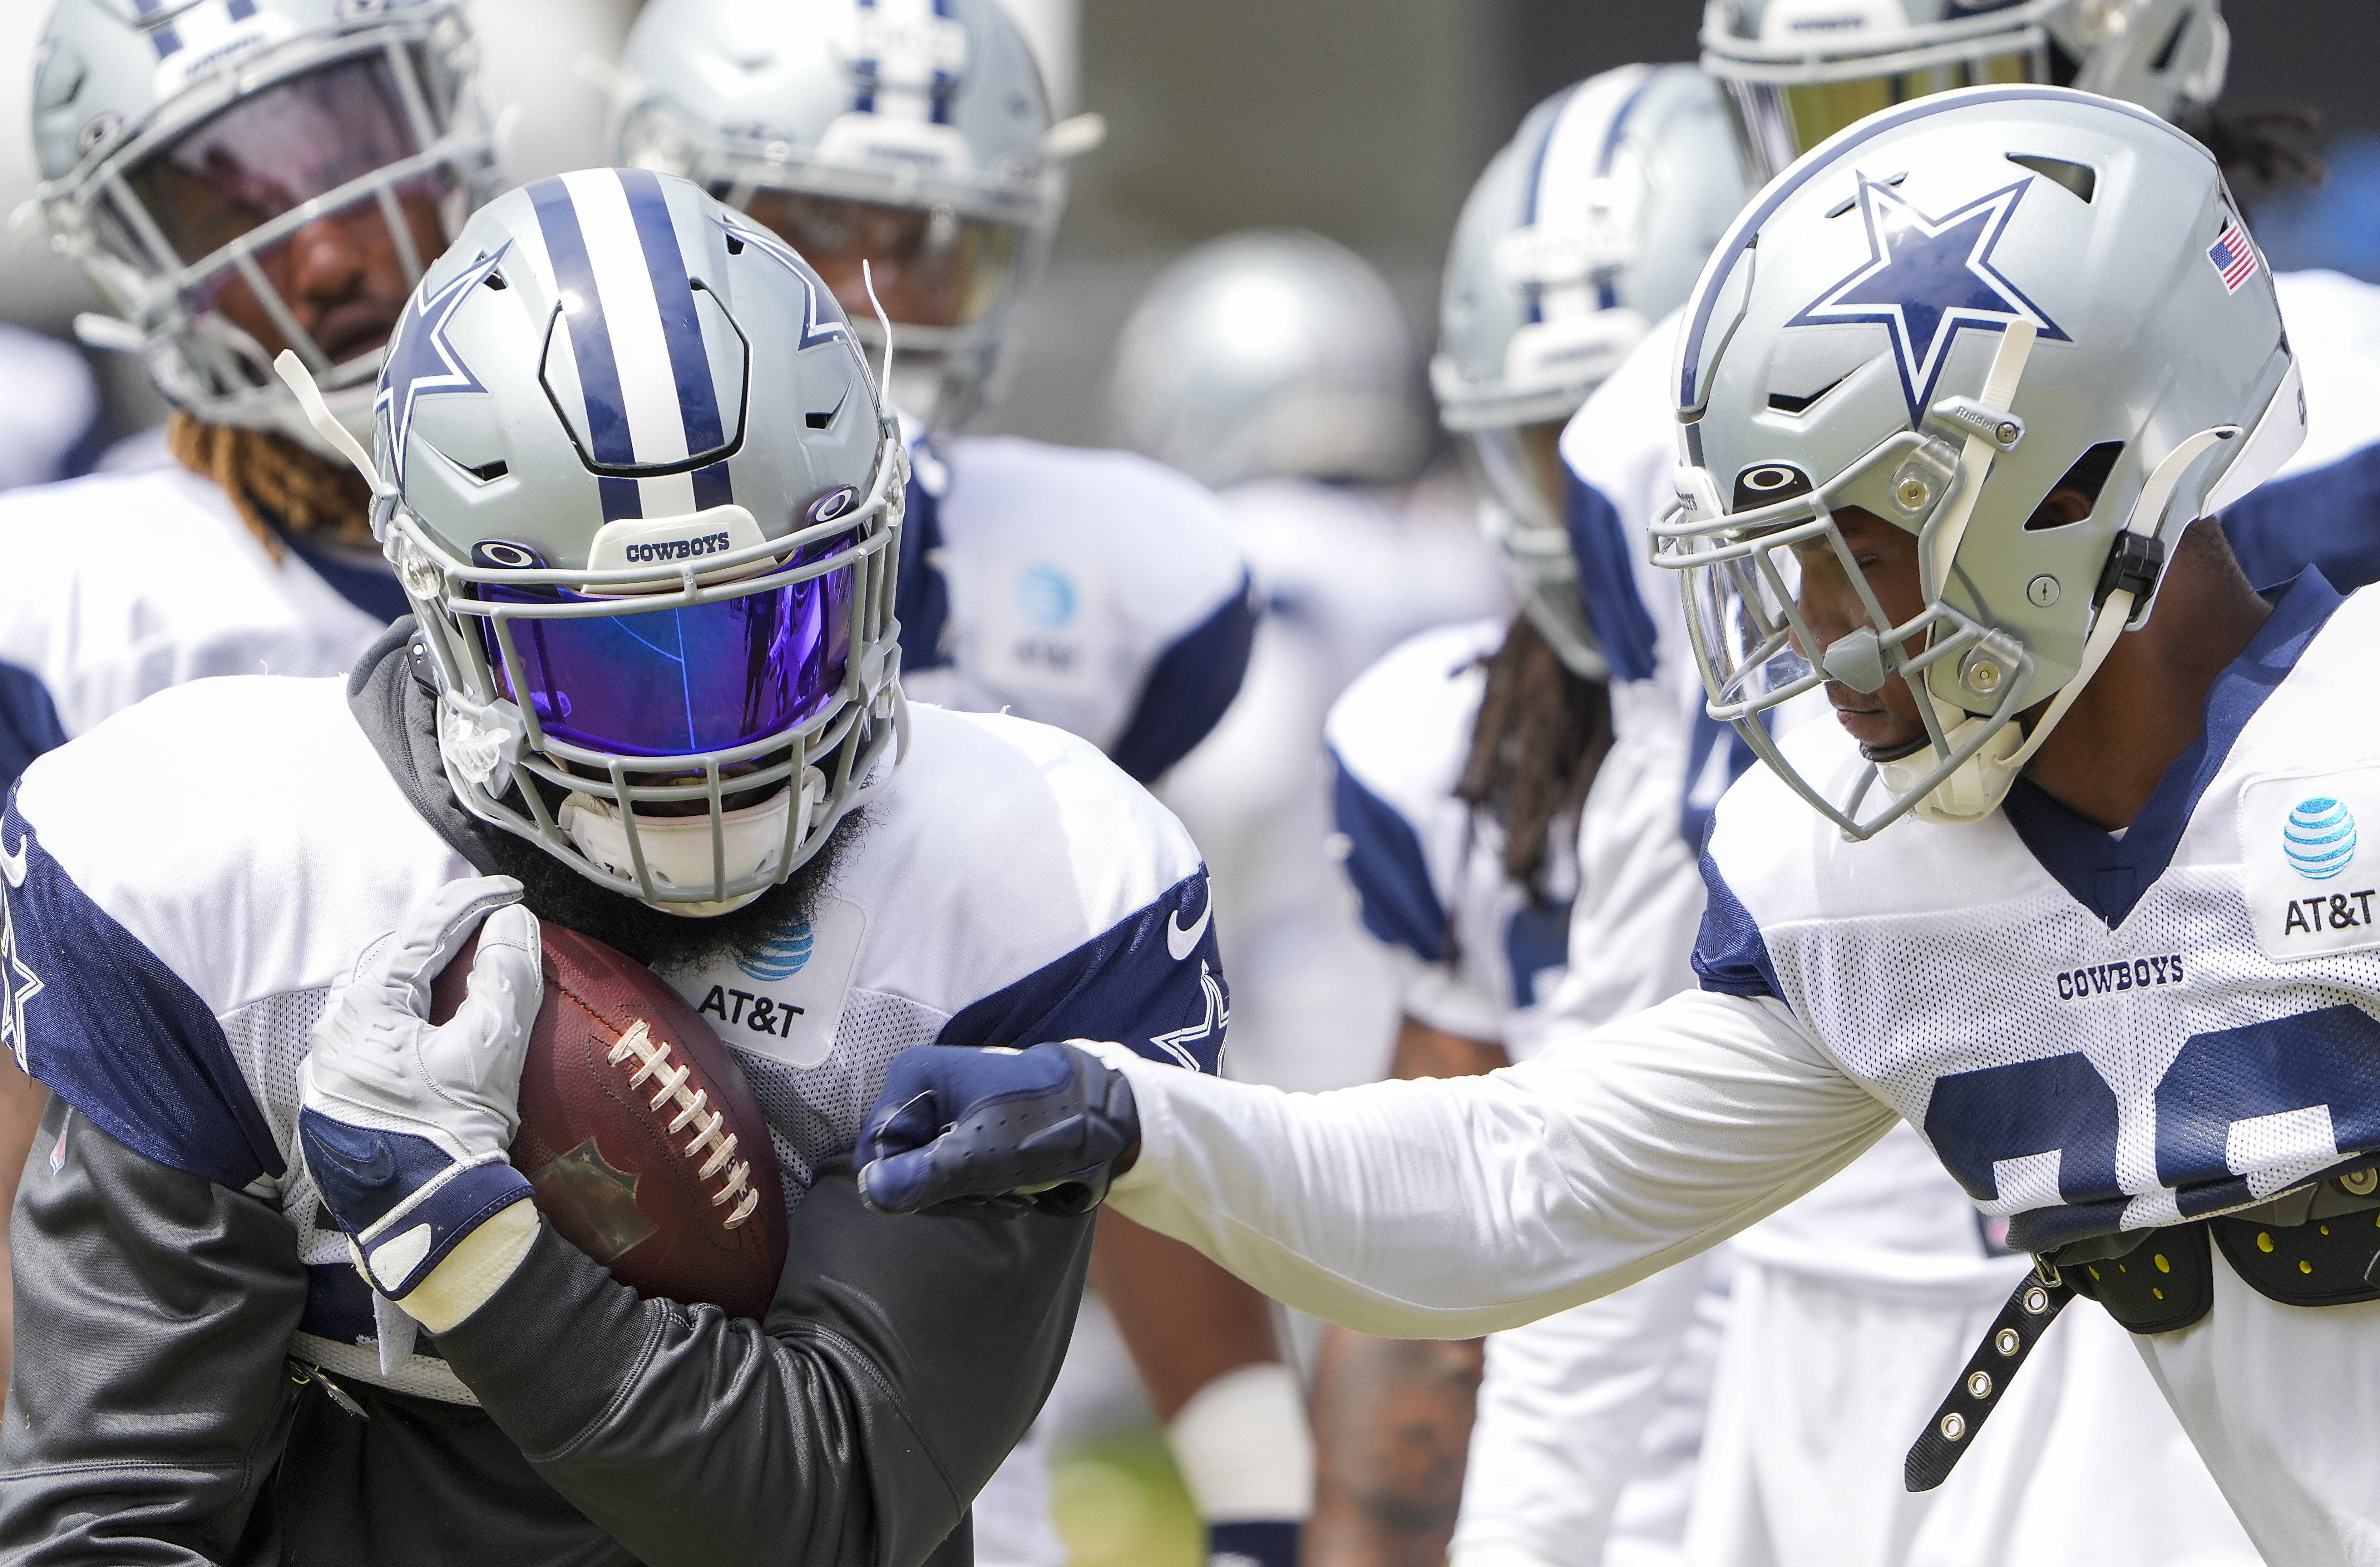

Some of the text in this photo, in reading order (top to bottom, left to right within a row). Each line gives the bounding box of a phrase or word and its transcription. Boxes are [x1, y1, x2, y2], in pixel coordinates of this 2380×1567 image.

[1956, 406, 1996, 431] Riddell
[626, 532, 730, 562] COWBOYS
[2285, 888, 2375, 935] AT&T
[2056, 954, 2183, 1000] COWBOYS
[697, 984, 804, 1038] AT&T
